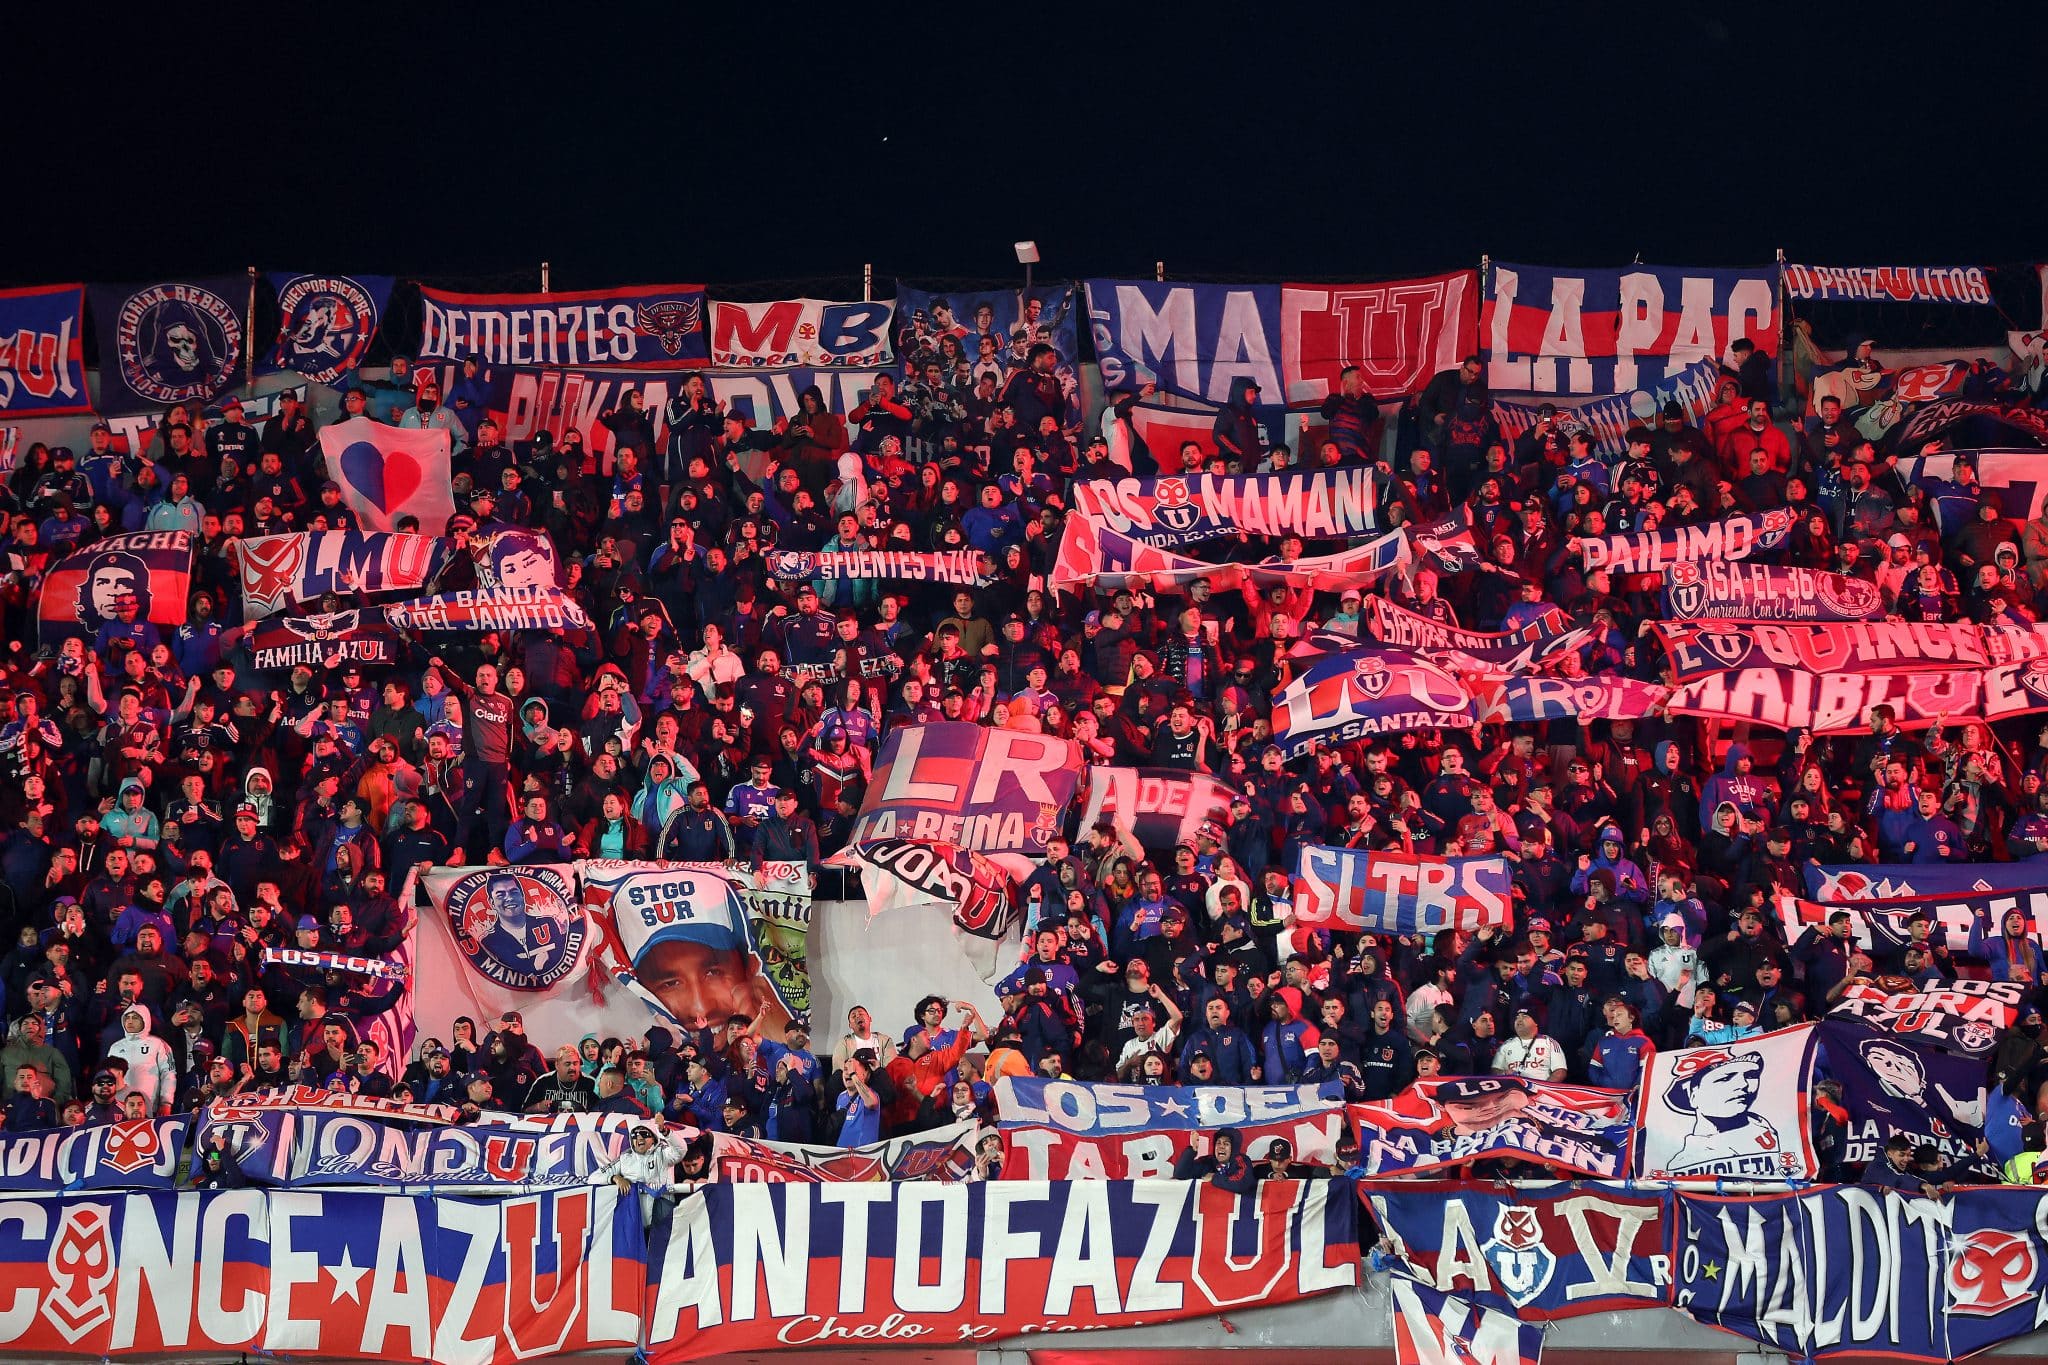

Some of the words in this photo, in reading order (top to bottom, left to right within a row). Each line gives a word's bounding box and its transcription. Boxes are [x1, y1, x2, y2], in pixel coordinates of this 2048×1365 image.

[119, 287, 170, 347] FLORIDA
[1201, 466, 1376, 536] MAMANI
[414, 597, 446, 612] LA
[455, 587, 551, 608] BANDA
[411, 610, 457, 631] DEL
[465, 605, 564, 631] JAIMITO
[255, 642, 324, 669] FAMILIA
[337, 640, 388, 662] AZUL
[475, 707, 508, 723] Claro
[537, 869, 573, 904] NORMAL
[628, 880, 695, 906] STGO
[1294, 845, 1504, 932] SLTBS
[640, 901, 695, 927] SUR
[265, 947, 320, 967] LOS
[1922, 978, 2025, 1005] LOS
[994, 1075, 1151, 1131] LOS
[1847, 1119, 1880, 1141] LA
[1011, 1112, 1343, 1181] TABON
[1843, 1142, 1878, 1163] DE
[358, 1186, 643, 1365] AZUL
[649, 1180, 1356, 1345] ANTOFAZUL
[777, 1312, 935, 1345] Chelo
